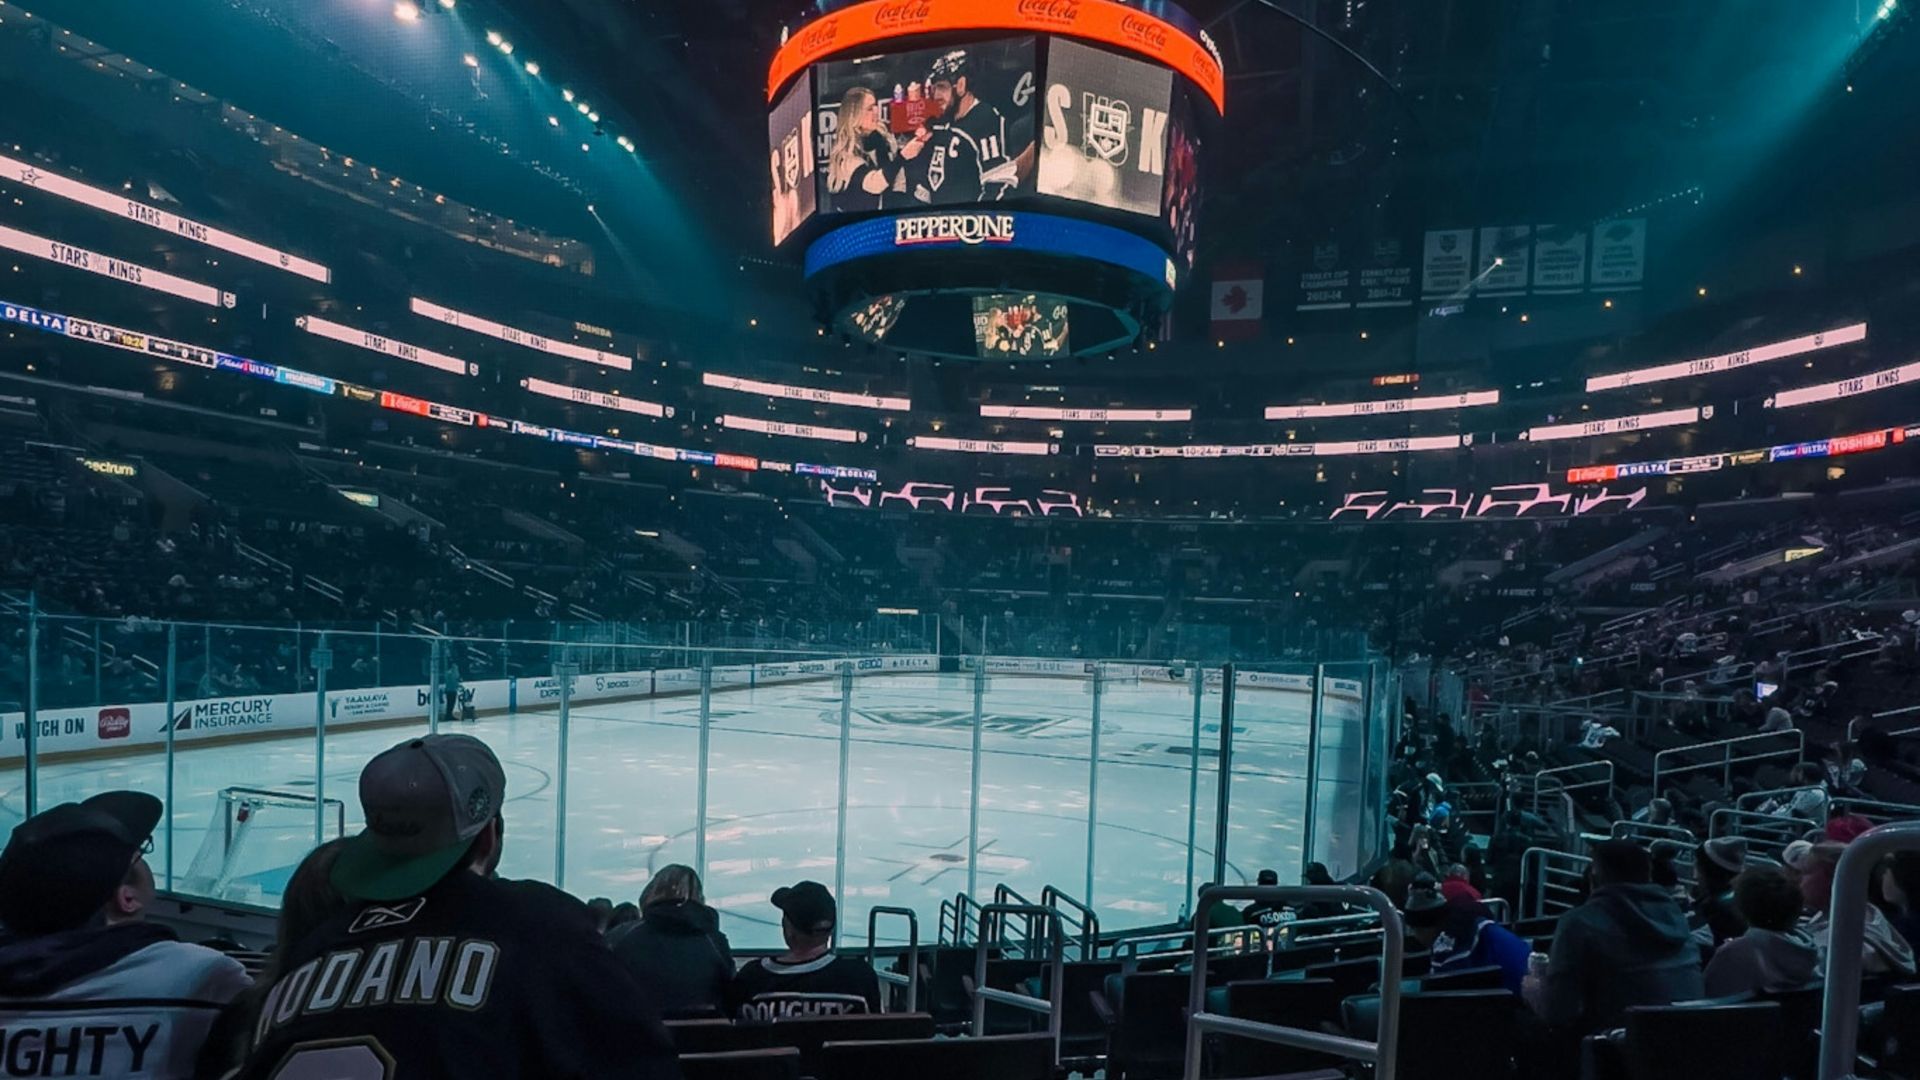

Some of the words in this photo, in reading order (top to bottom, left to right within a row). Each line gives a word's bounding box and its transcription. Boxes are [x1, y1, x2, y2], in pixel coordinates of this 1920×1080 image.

[127, 202, 161, 226] STARS
[178, 218, 208, 242] KINGS
[895, 215, 1015, 244] PEPPERDINE
[50, 242, 89, 267] STARS
[108, 258, 142, 282] KINGS
[5, 305, 62, 330] DELTA
[575, 322, 612, 338] TOSHIBA
[1689, 359, 1715, 374] STARS
[1728, 351, 1750, 367] KINGS
[1838, 380, 1863, 396] STARS
[1876, 369, 1900, 387] KINGS
[1583, 422, 1606, 434] STARS
[1834, 434, 1881, 450] TOSHIBA
[847, 469, 874, 479] DELTA
[1631, 464, 1664, 475] DELTA
[195, 699, 272, 717] MERCURY
[16, 720, 59, 739] WTCH
[64, 718, 84, 734] ON
[194, 712, 272, 729] INSURANCE
